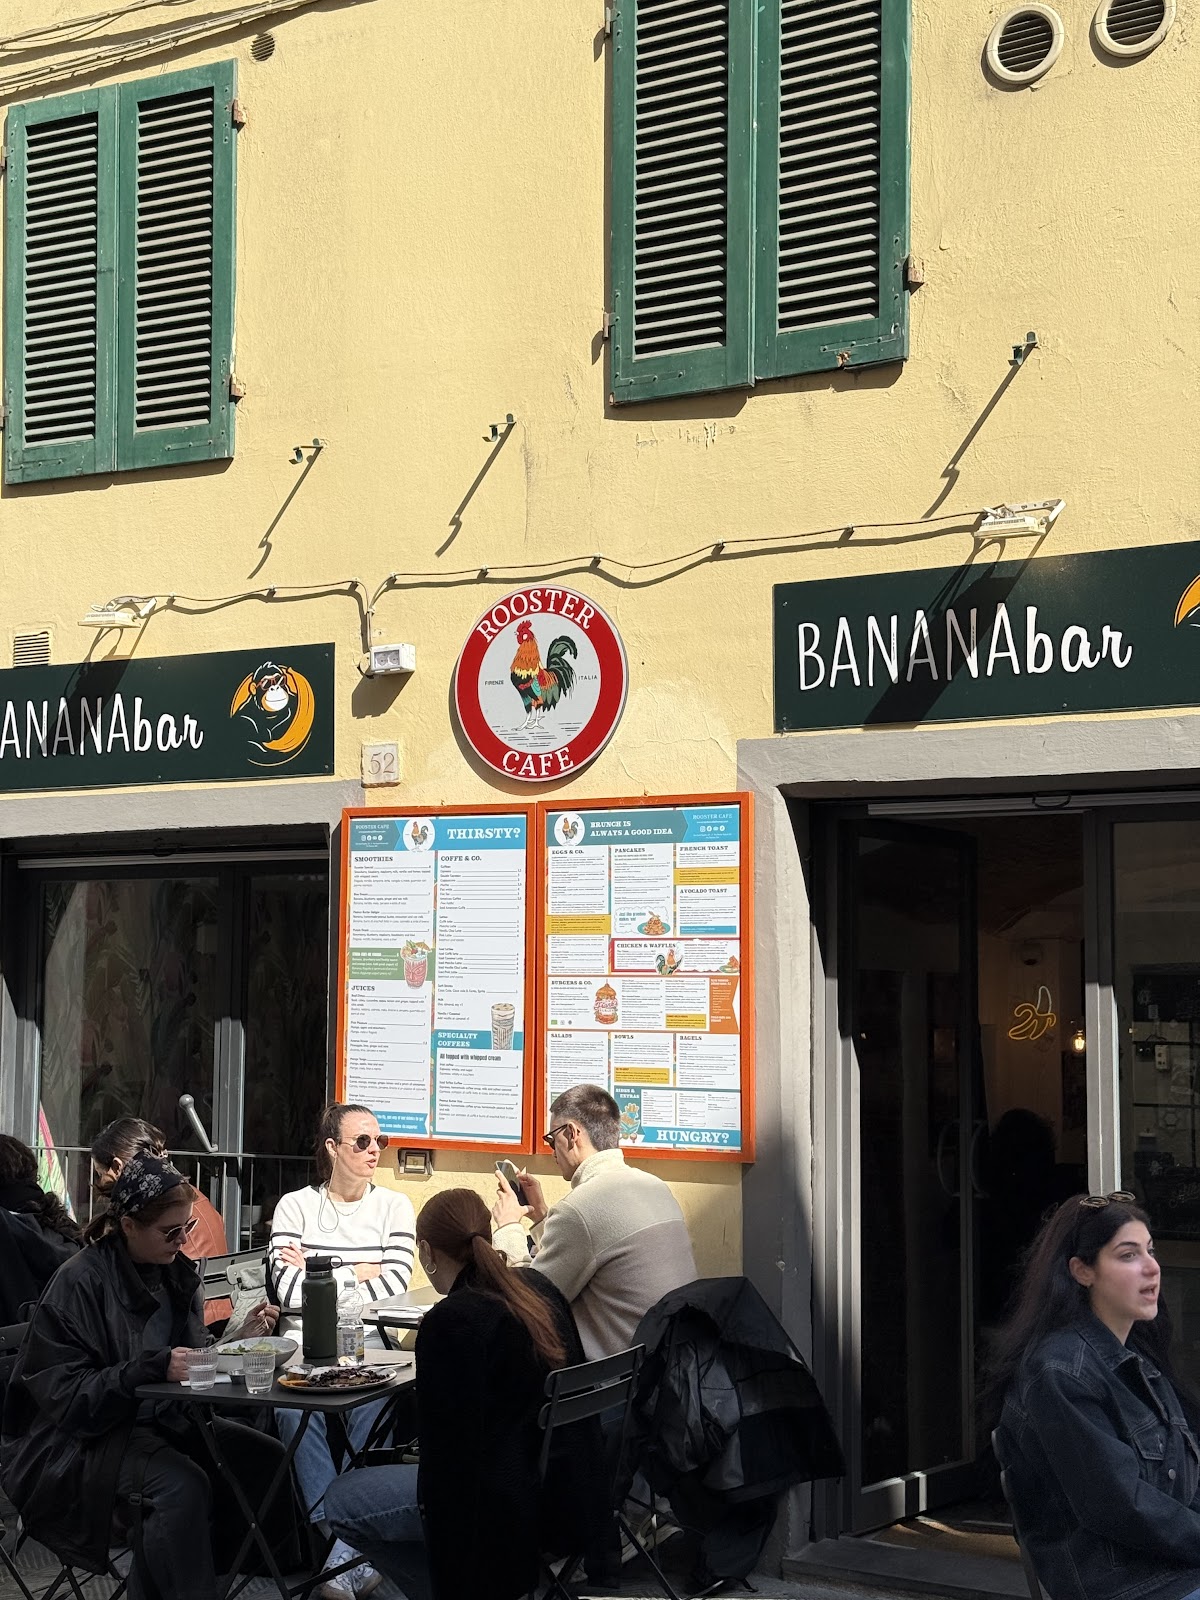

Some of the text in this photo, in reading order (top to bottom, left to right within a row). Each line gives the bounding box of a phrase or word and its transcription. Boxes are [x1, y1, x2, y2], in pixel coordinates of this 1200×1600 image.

[476, 589, 595, 643] ROOSTER
[798, 602, 1133, 691] BANANAbar
[368, 752, 395, 775] 52
[502, 747, 574, 777] CAFE
[447, 827, 521, 839] THIRSTY?
[590, 829, 623, 837] ALWAYS
[656, 1129, 730, 1144] HUNGRY?
